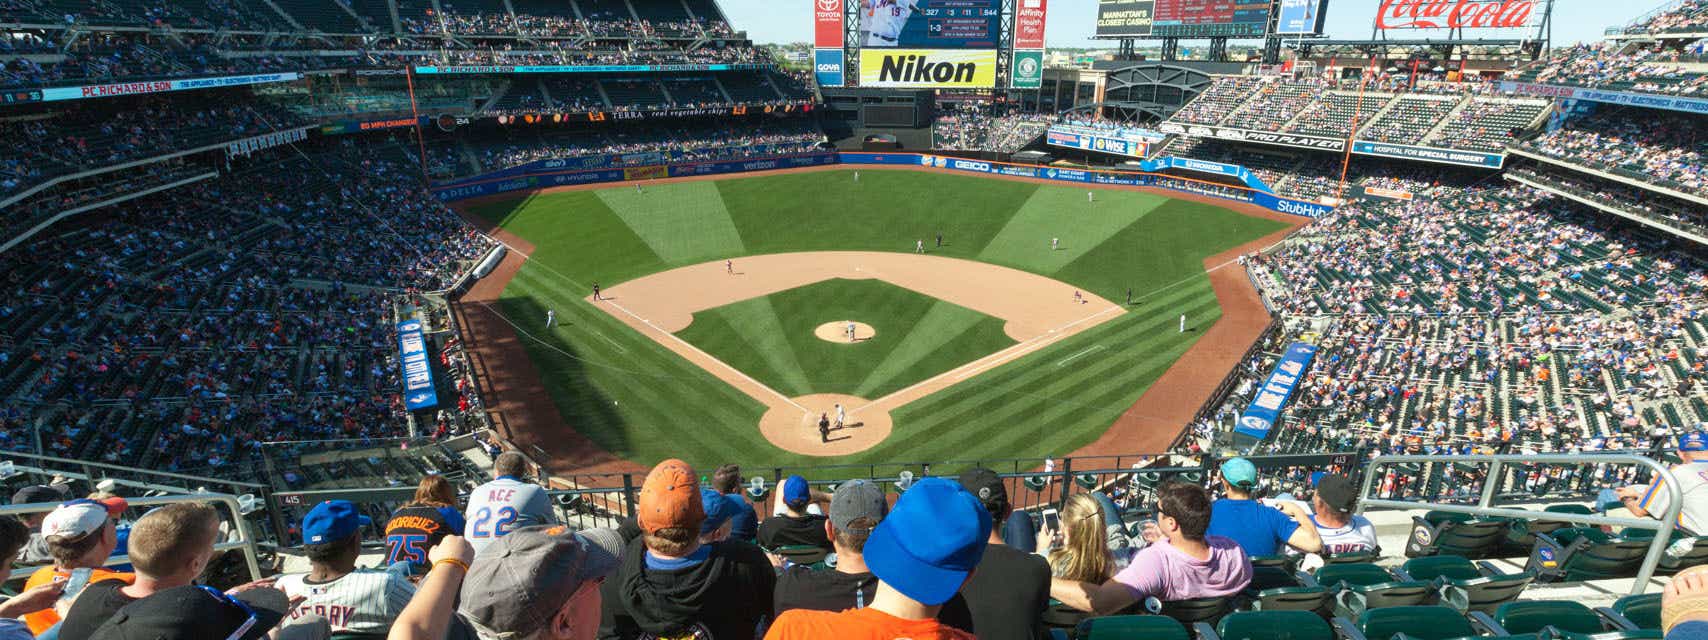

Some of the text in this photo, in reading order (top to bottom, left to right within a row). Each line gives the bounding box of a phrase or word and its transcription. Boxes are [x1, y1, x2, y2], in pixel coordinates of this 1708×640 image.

[1020, 8, 1045, 18] Affinity
[1102, 10, 1148, 19] MANHATTAN'S
[1020, 18, 1042, 26] Health
[1097, 18, 1152, 27] CLOSEST CASINO
[817, 63, 841, 72] GOYA
[879, 54, 976, 83] Nikon
[99, 82, 145, 96] RICHARD
[146, 82, 153, 93] &
[154, 81, 172, 92] SON
[612, 106, 728, 120] TERRA real vegetable chips
[1105, 139, 1127, 153] WISE
[1245, 132, 1344, 150] PRO PLAYER
[1373, 146, 1404, 155] HOSPITAL
[1404, 149, 1418, 157] FOR
[1418, 150, 1449, 160] SPECIAL
[1449, 153, 1486, 163] SURGERY
[743, 160, 776, 170] verizon
[955, 160, 990, 172] GEICO
[1193, 162, 1225, 172] HONDA
[567, 173, 600, 181] HYUNDAI
[450, 185, 483, 198] DELTA
[1277, 199, 1327, 218] StubHub
[284, 495, 301, 504] 415
[488, 489, 517, 502] ACE
[385, 515, 441, 536] RODRIGUEZ
[472, 505, 519, 538] 22
[386, 534, 428, 566] 75
